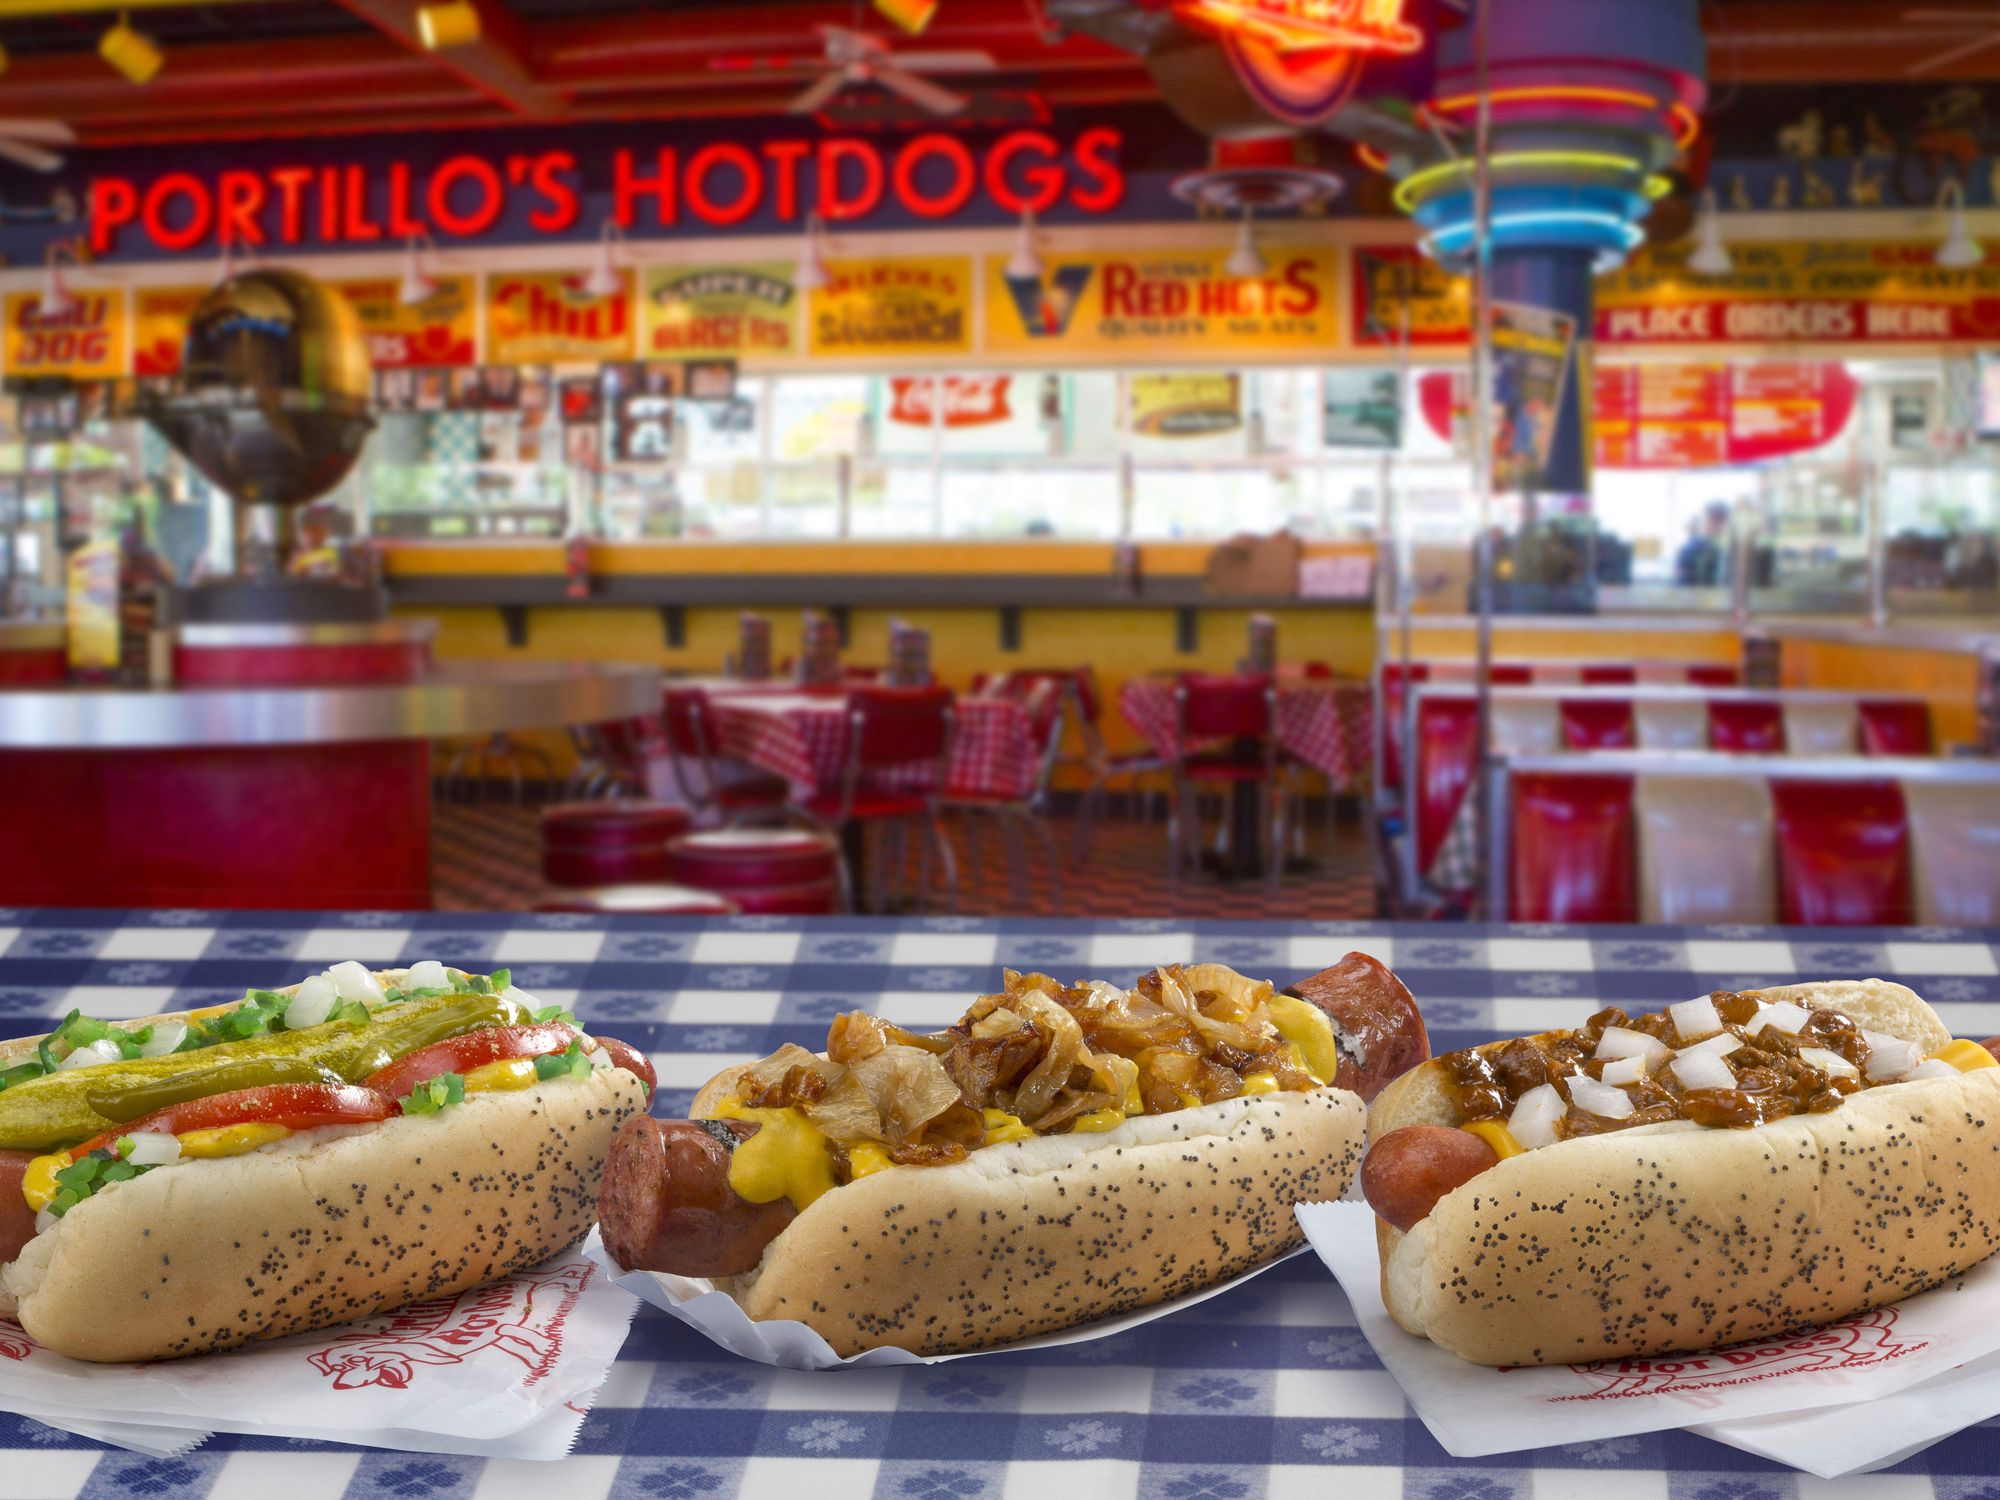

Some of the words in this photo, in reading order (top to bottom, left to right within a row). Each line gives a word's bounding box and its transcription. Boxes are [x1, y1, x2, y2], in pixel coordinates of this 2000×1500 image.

[90, 151, 580, 253] PORTILLO'S
[612, 127, 1125, 228] HOTDOGS
[1103, 264, 1190, 317] RED
[1201, 257, 1320, 318] HOTS
[652, 315, 790, 351] BURGERS
[1609, 309, 1708, 338] PLACE
[1724, 303, 1855, 337] ORDERS
[1866, 302, 1951, 335] HERE
[15, 331, 109, 365] DOG
[1618, 1358, 1709, 1375] HOT
[1720, 1333, 1842, 1365] DOGS
